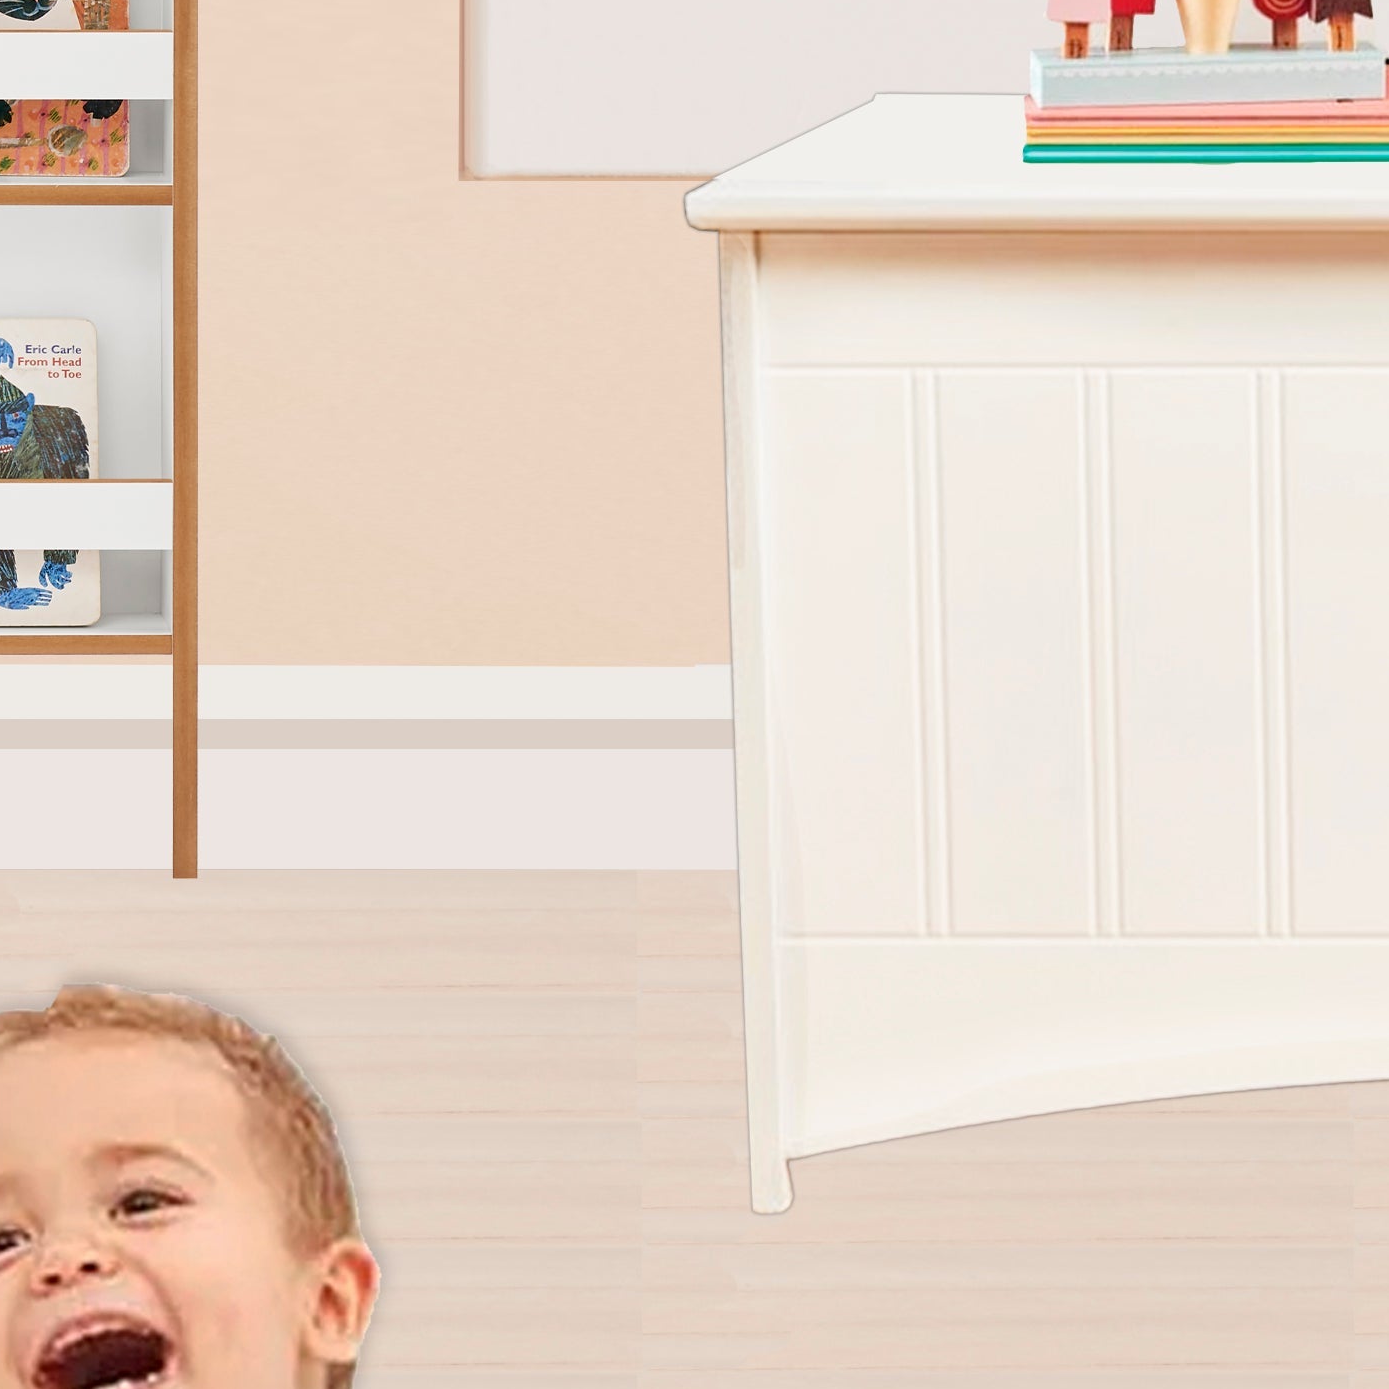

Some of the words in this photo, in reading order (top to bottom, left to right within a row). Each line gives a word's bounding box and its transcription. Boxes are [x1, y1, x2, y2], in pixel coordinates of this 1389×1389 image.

[25, 344, 47, 354] Eric
[51, 345, 82, 354] Carle
[18, 357, 48, 366] From
[52, 357, 82, 366] Head
[62, 369, 82, 378] Toe
